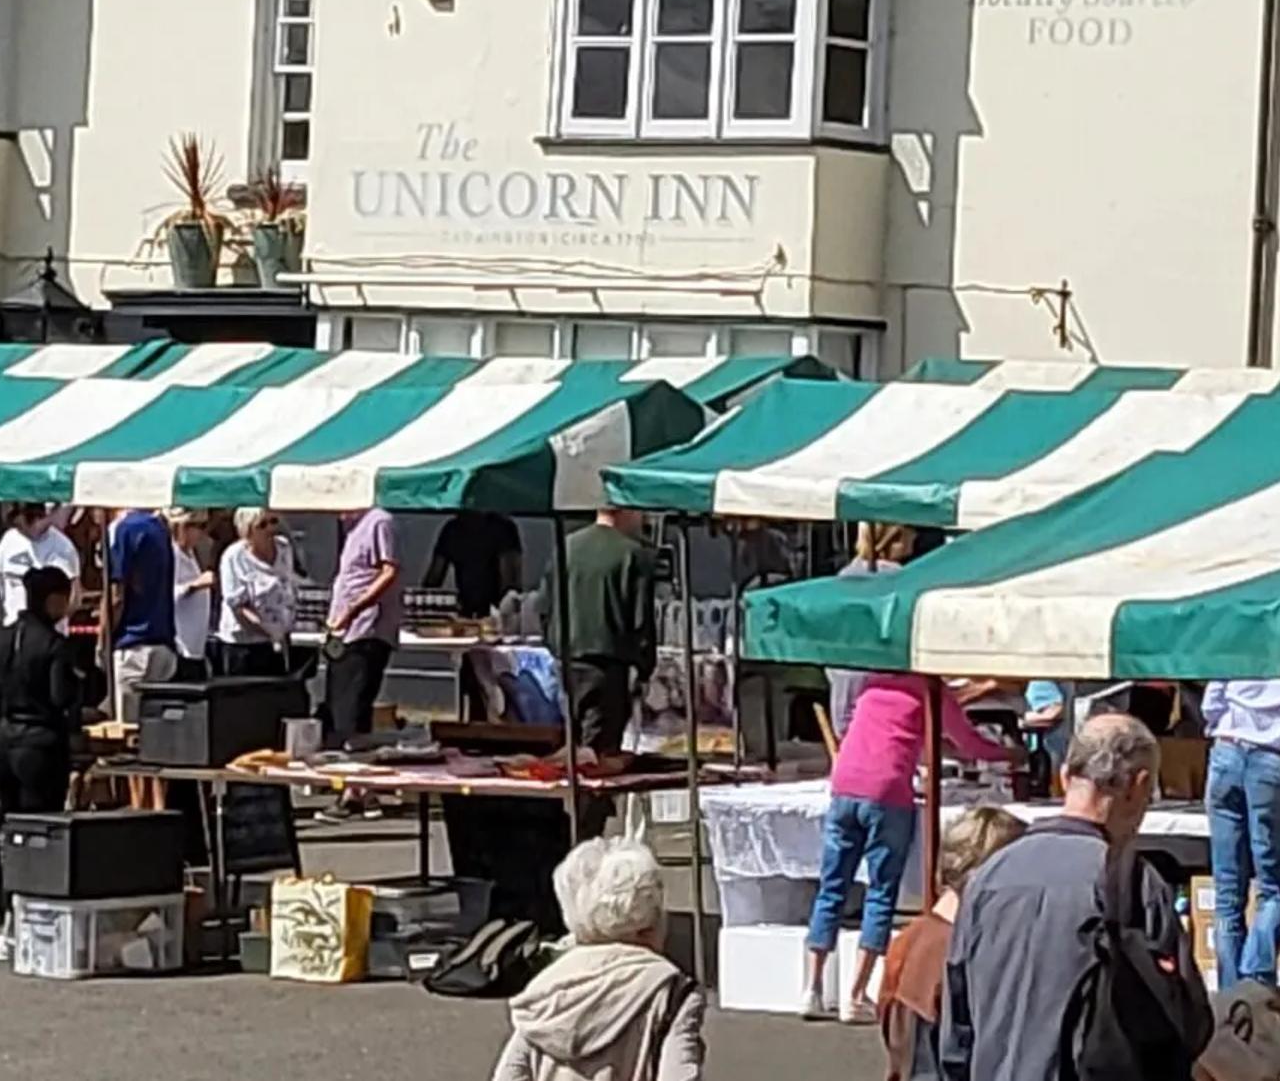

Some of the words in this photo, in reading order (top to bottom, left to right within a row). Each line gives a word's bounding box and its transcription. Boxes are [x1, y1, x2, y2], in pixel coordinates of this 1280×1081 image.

[1028, 17, 1134, 46] FOOD
[415, 122, 479, 161] The
[352, 170, 628, 223] UNICORN
[646, 172, 760, 225] INN
